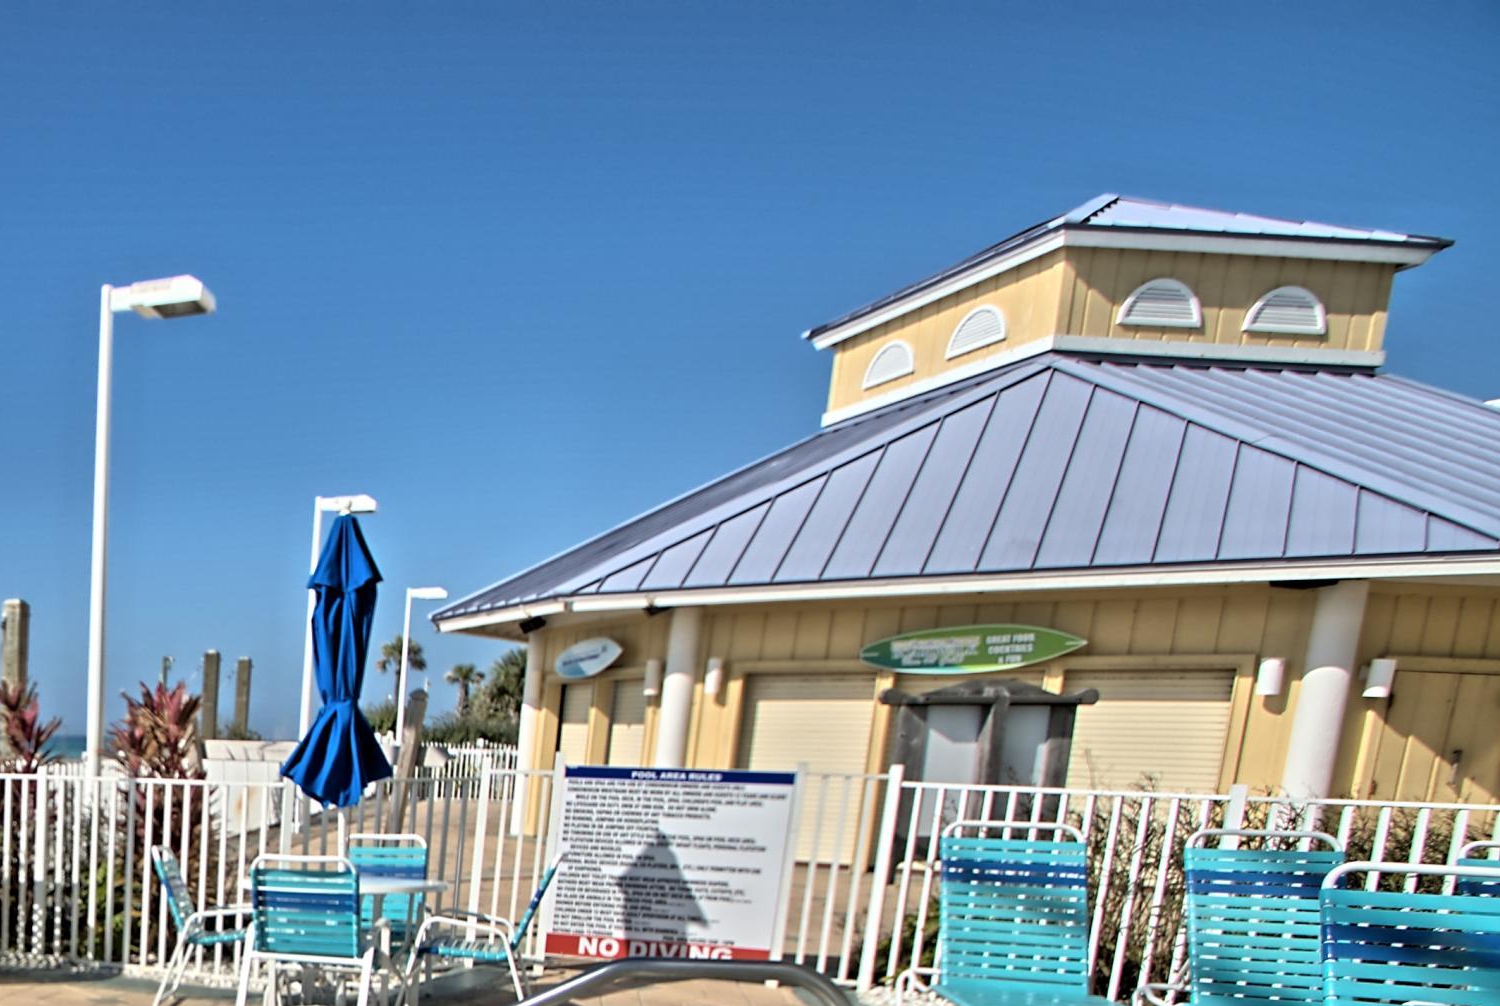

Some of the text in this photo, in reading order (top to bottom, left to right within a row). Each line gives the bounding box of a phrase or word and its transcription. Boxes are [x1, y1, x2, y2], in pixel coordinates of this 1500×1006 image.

[631, 771, 723, 781] POOL AREA RULES
[578, 938, 733, 960] NO DIVING
